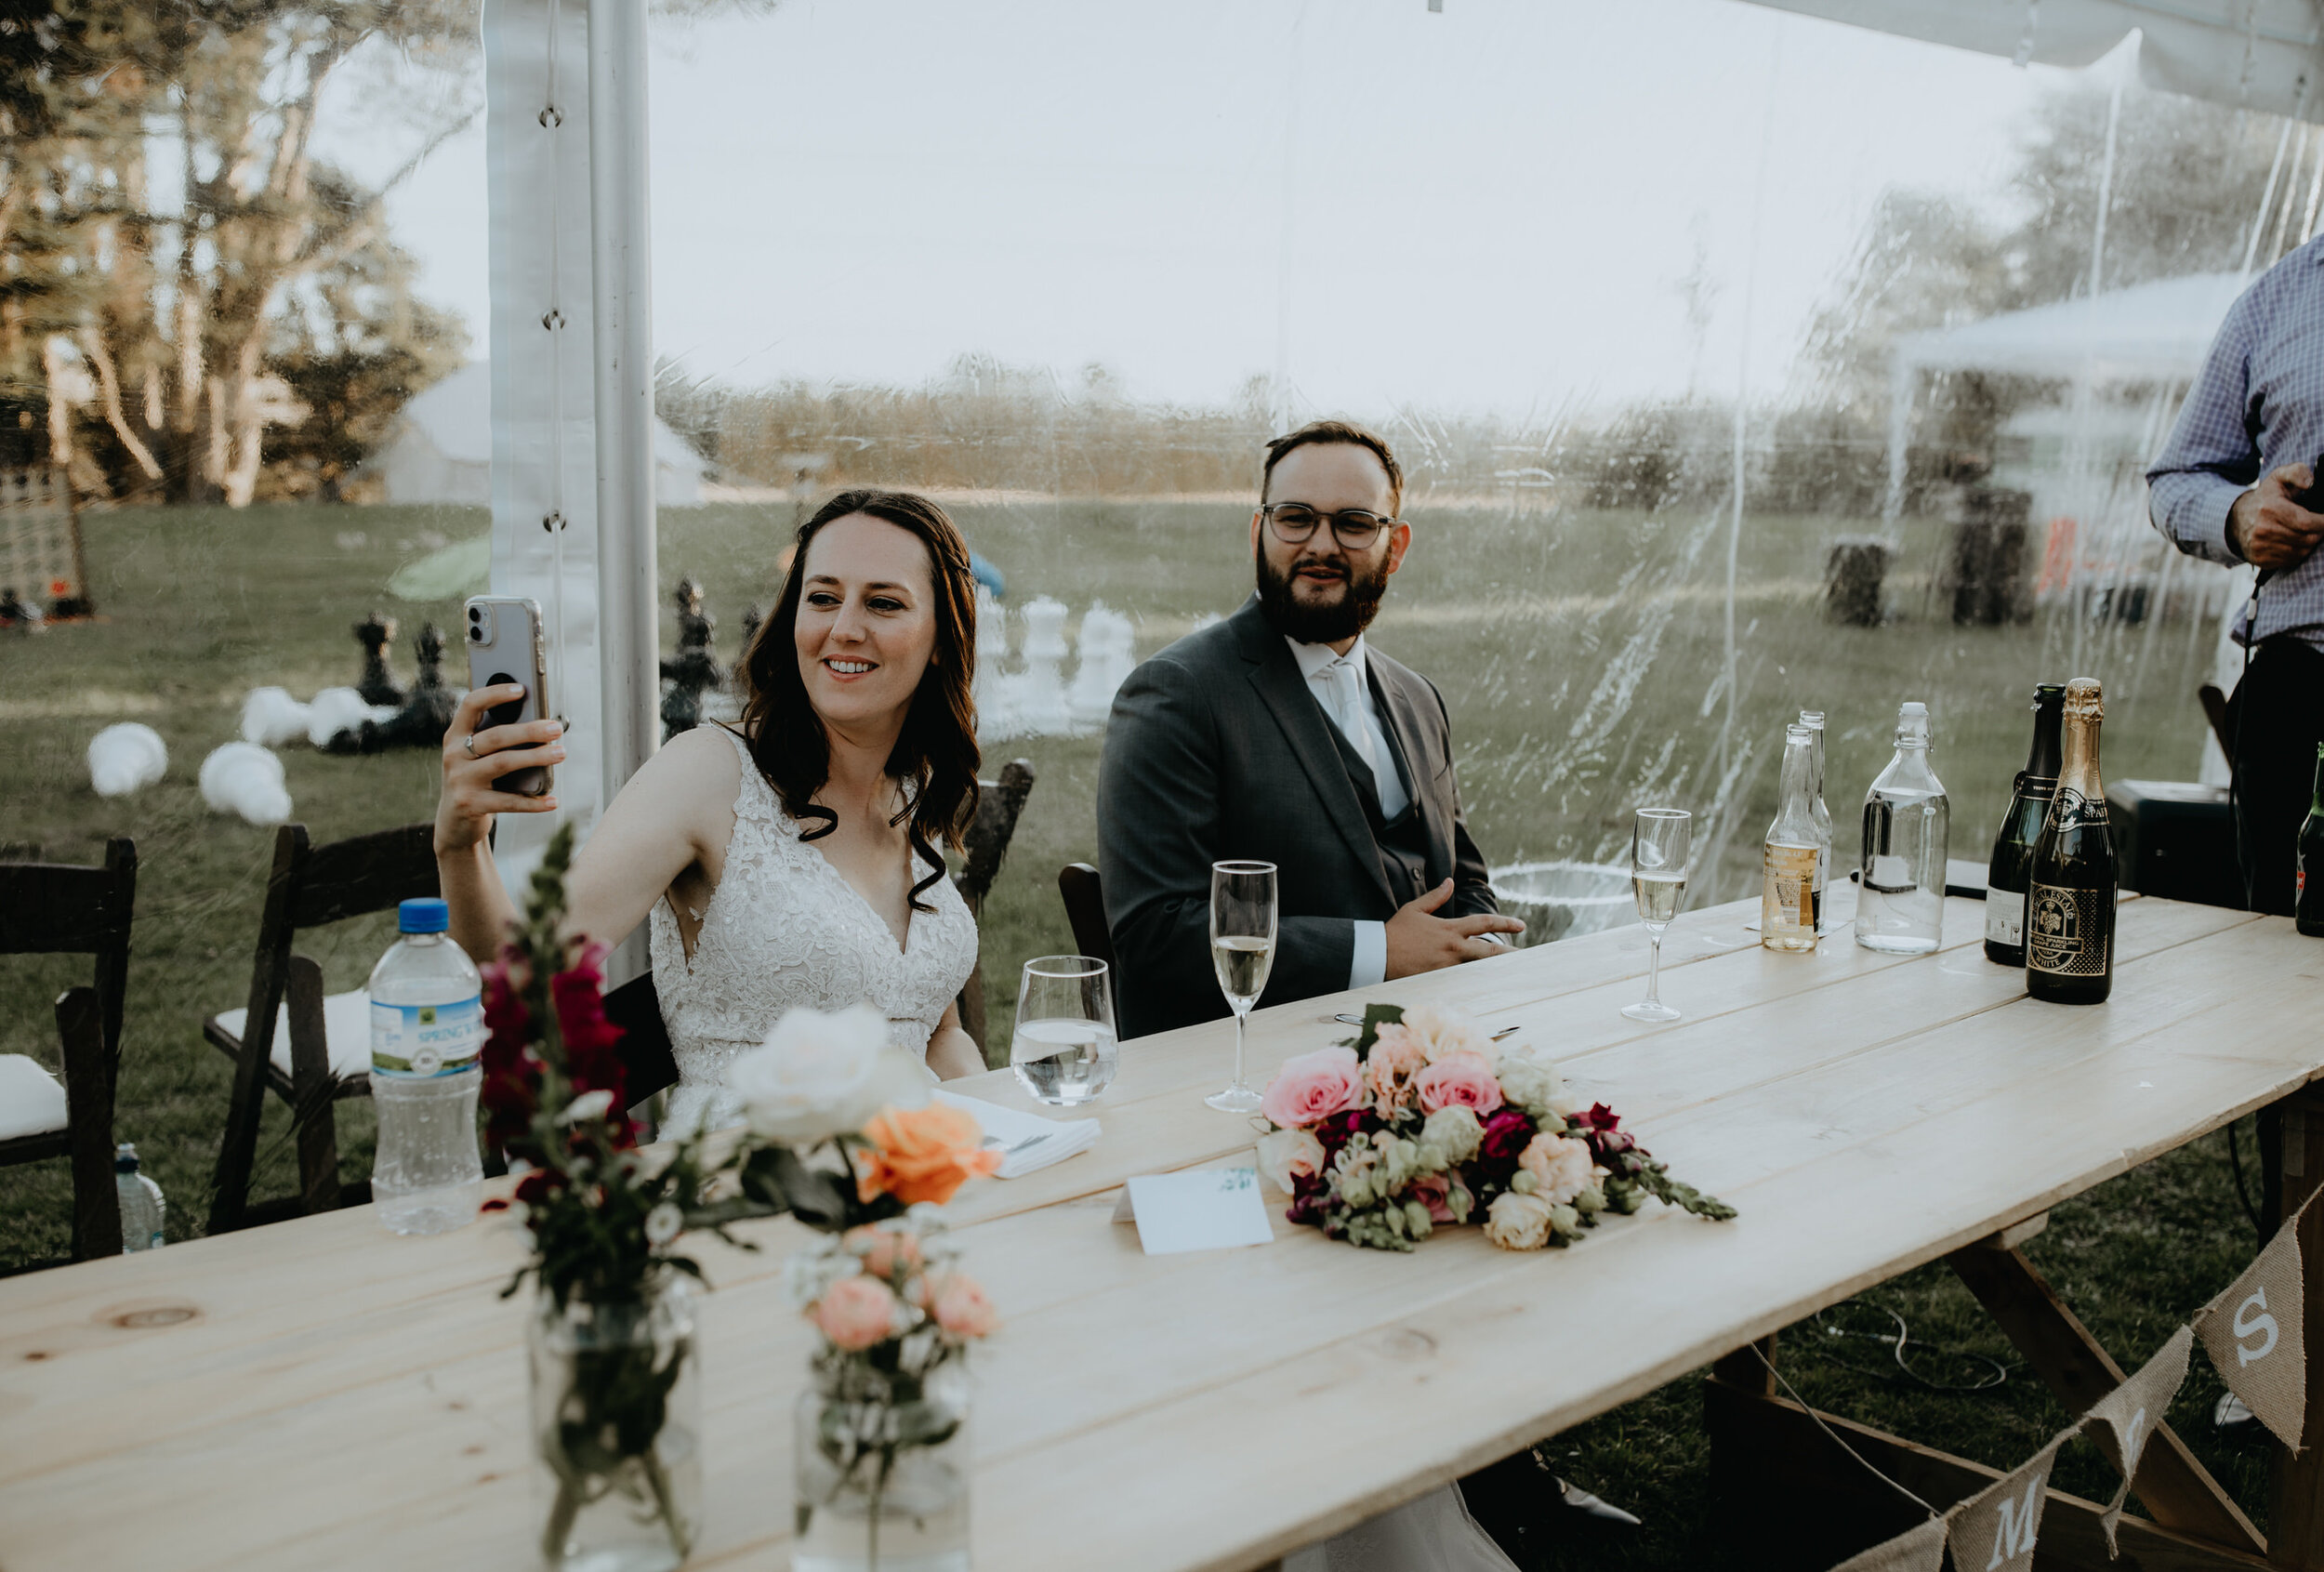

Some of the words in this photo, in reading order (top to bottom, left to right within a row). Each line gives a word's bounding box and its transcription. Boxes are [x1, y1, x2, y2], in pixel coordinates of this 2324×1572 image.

[2051, 890, 2076, 918] ESTAT
[2046, 937, 2080, 946] SPARKLING
[2036, 956, 2061, 968] WHITE
[417, 1024, 463, 1042] SPRING
